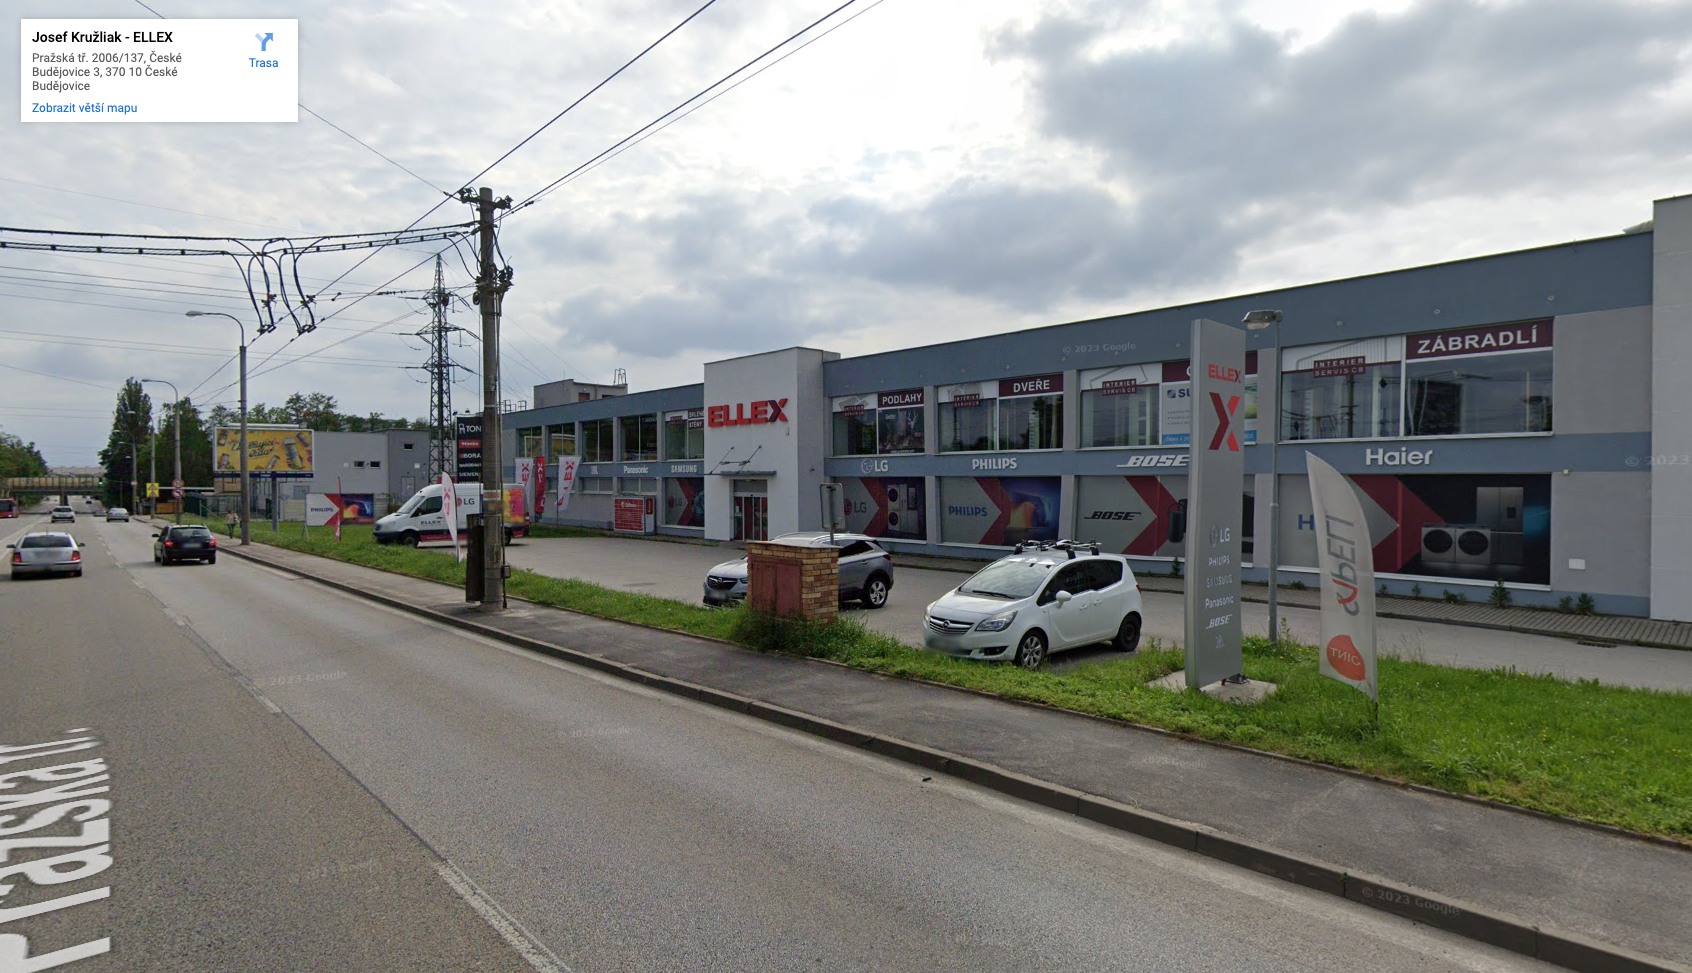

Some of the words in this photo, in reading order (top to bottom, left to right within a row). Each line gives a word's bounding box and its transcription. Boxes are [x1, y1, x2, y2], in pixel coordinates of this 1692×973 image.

[1417, 325, 1539, 355] ZÁBRADLÍ
[1314, 357, 1365, 368] INTERIER
[1208, 363, 1242, 383] ELLEX
[1314, 367, 1350, 377] SERVIS
[1350, 366, 1365, 374] CB
[1013, 378, 1050, 393] DVEŘE
[1103, 379, 1136, 388] INTERIER
[882, 393, 922, 405] PODLAHY
[708, 398, 789, 428] ELLEX
[466, 425, 482, 433] TON
[1117, 454, 1191, 468] BOSE
[1365, 446, 1433, 466] Haier
[623, 465, 649, 475] Panasonic
[670, 464, 698, 473] SAMSUNG
[874, 460, 889, 472] LG
[972, 458, 1018, 470] PHILIPS
[463, 498, 475, 506] LG
[853, 502, 867, 514] LG
[948, 505, 988, 517] PHILIPS
[1084, 511, 1142, 521] BOSE
[1220, 527, 1231, 543] LG
[1208, 555, 1230, 567] PHILIPS
[1205, 594, 1234, 609] Panasonic
[1205, 613, 1233, 629] BOSE
